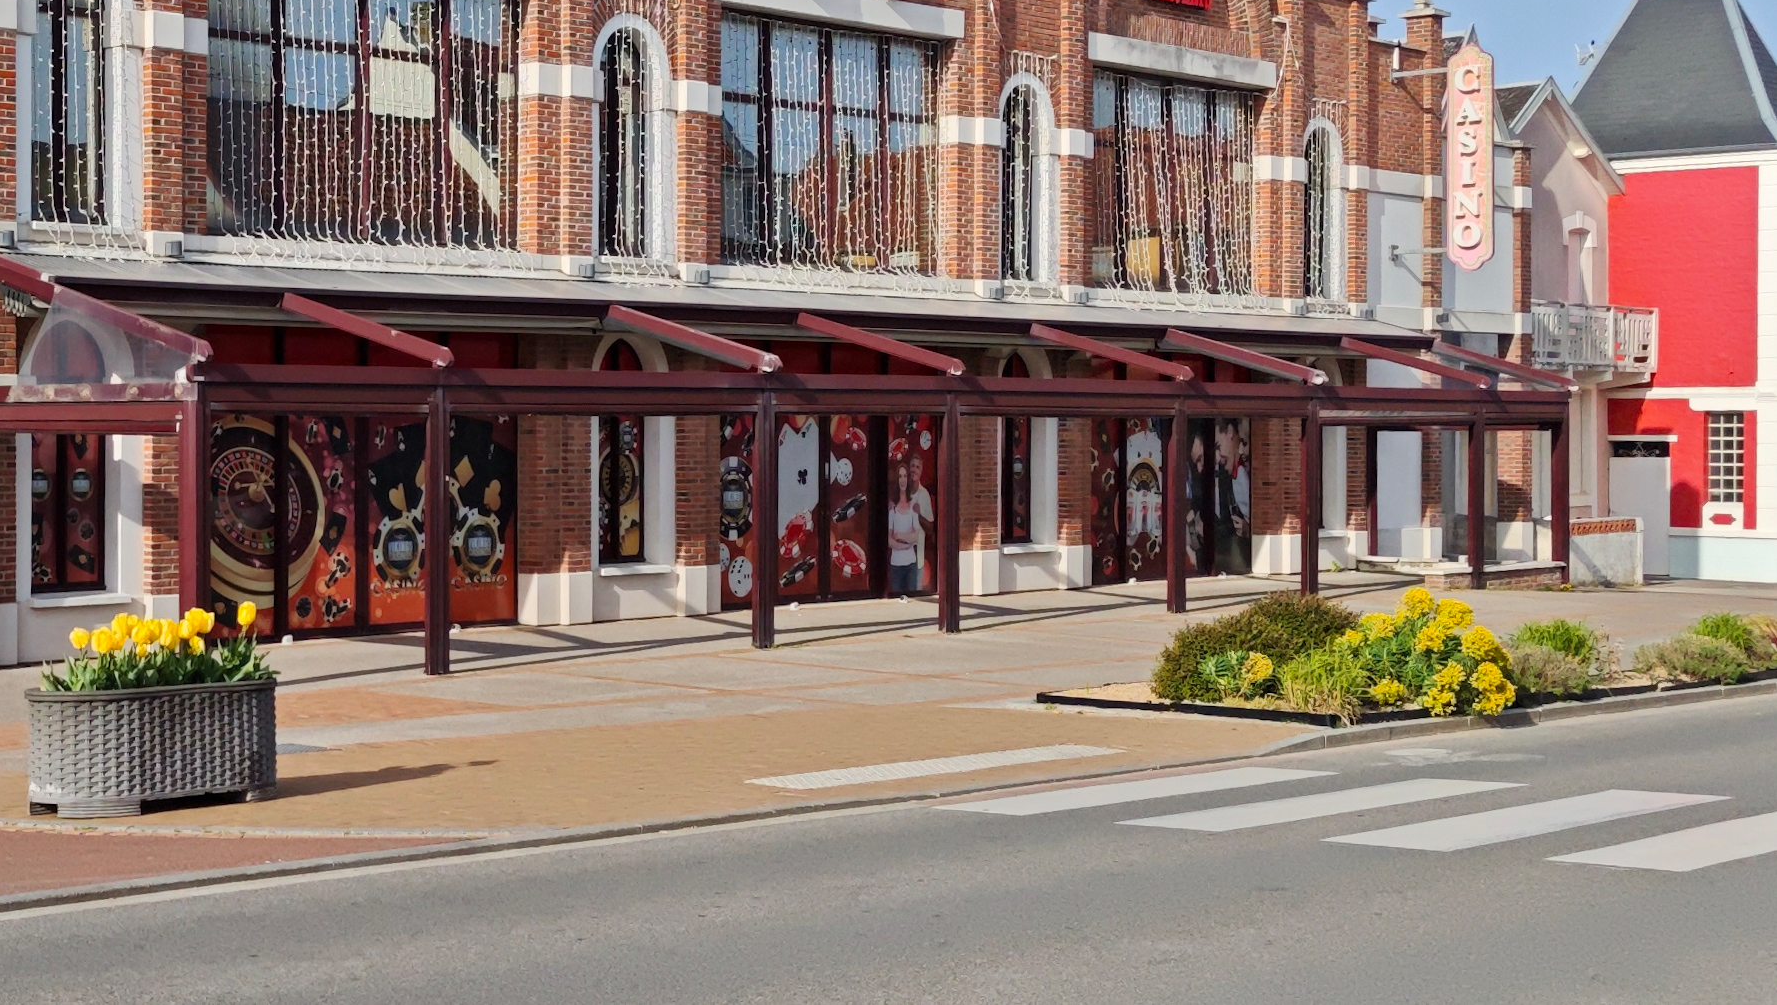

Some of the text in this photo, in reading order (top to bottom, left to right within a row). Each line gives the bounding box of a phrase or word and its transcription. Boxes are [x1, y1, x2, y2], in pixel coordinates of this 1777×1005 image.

[1452, 65, 1483, 250] CASINO
[388, 541, 413, 554] VIKINGS
[468, 537, 492, 550] VIKINGS
[451, 574, 508, 592] CASINO
